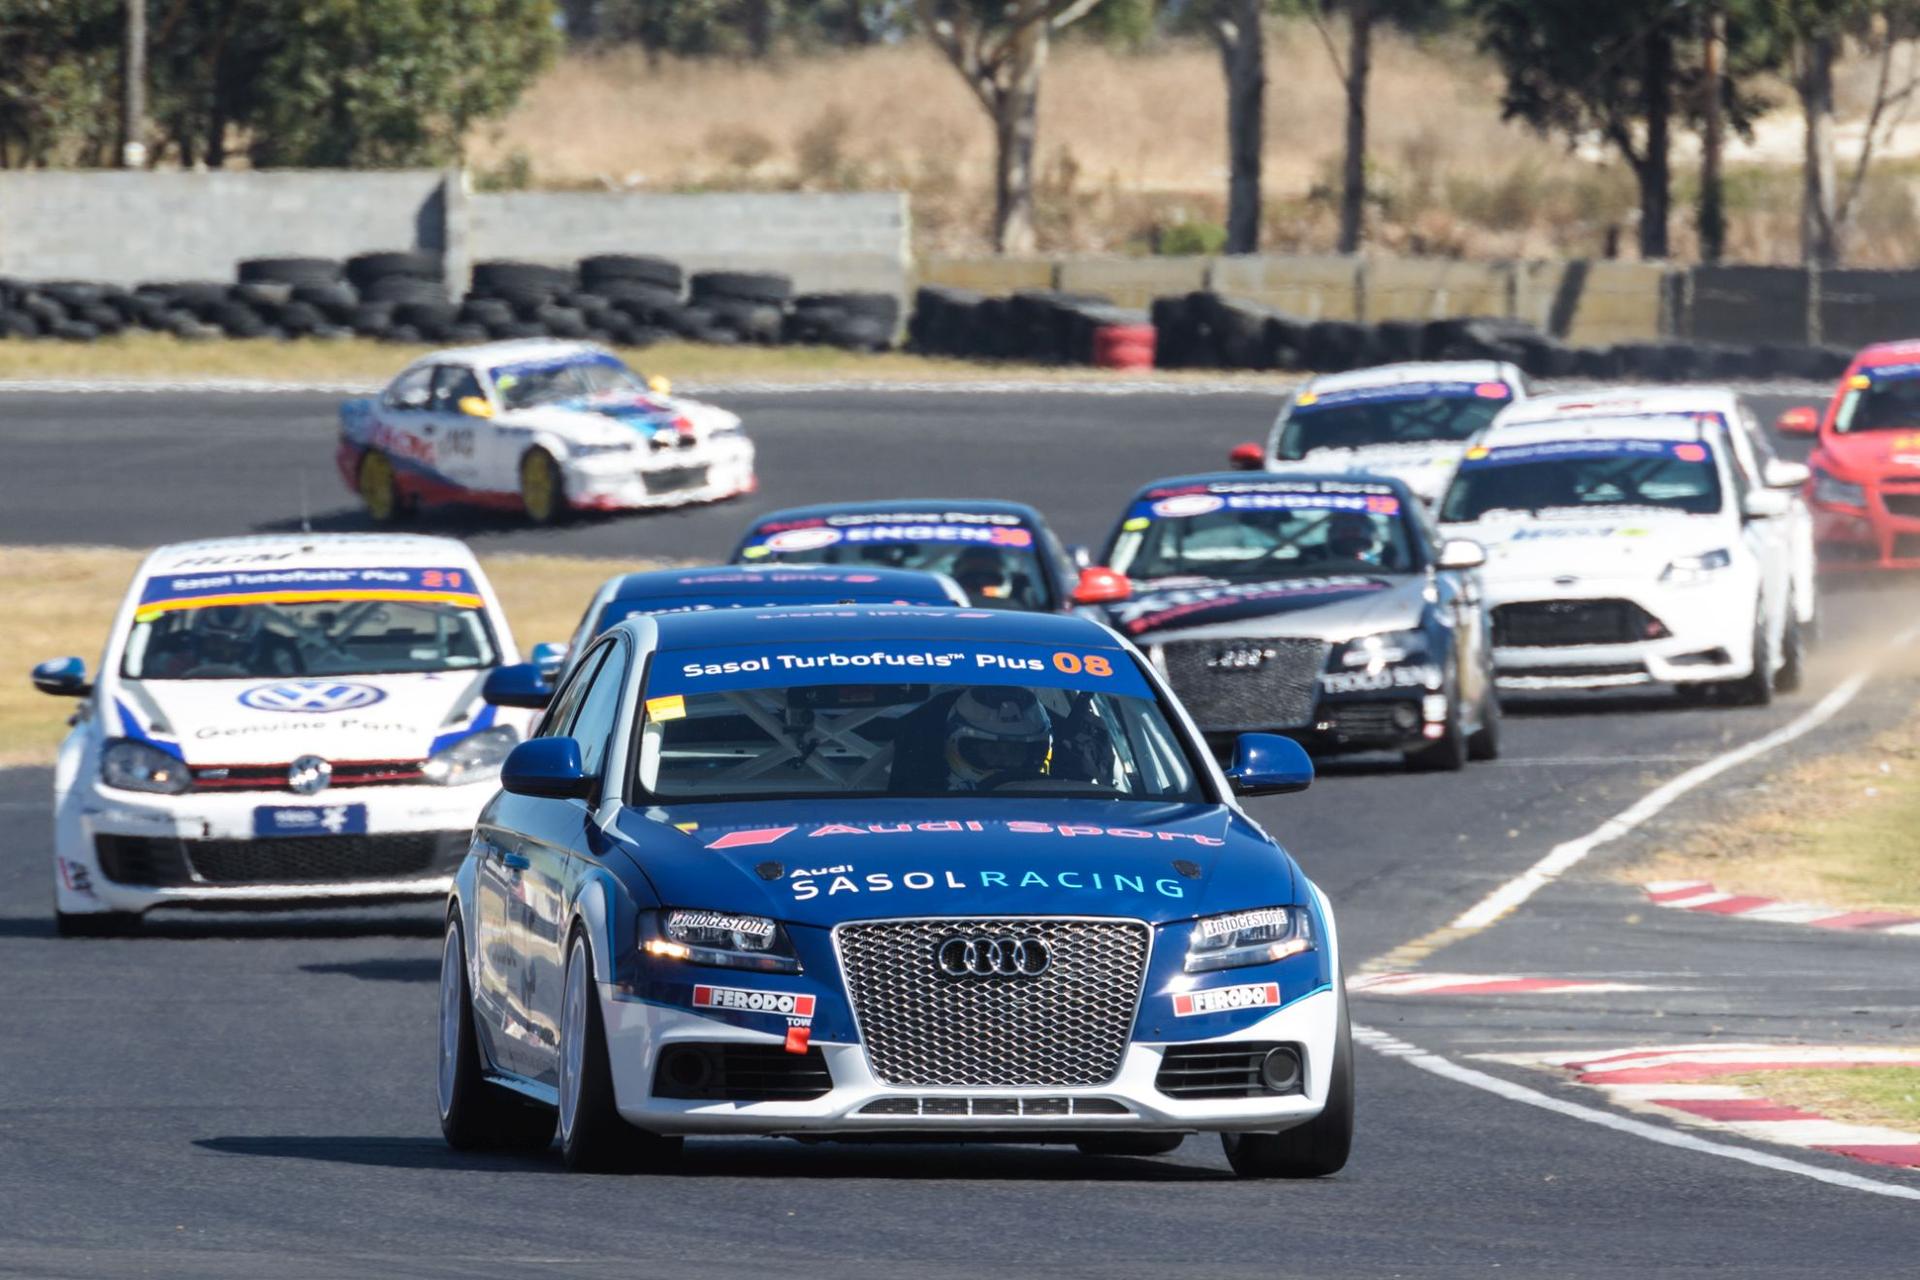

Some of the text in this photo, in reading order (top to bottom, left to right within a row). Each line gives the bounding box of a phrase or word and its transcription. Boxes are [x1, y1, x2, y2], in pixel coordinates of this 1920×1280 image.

[421, 570, 461, 588] 21
[682, 656, 770, 677] Sasol
[975, 654, 1045, 671] Plus
[1052, 651, 1114, 677] 08
[195, 719, 327, 739] Genuine
[808, 820, 1226, 846] Audi Sport
[789, 864, 854, 878] Audi
[791, 870, 1184, 901] SASOL RACING
[711, 989, 794, 1013] FERODO
[1194, 986, 1266, 1013] FERODO
[786, 1016, 812, 1027] TOW
